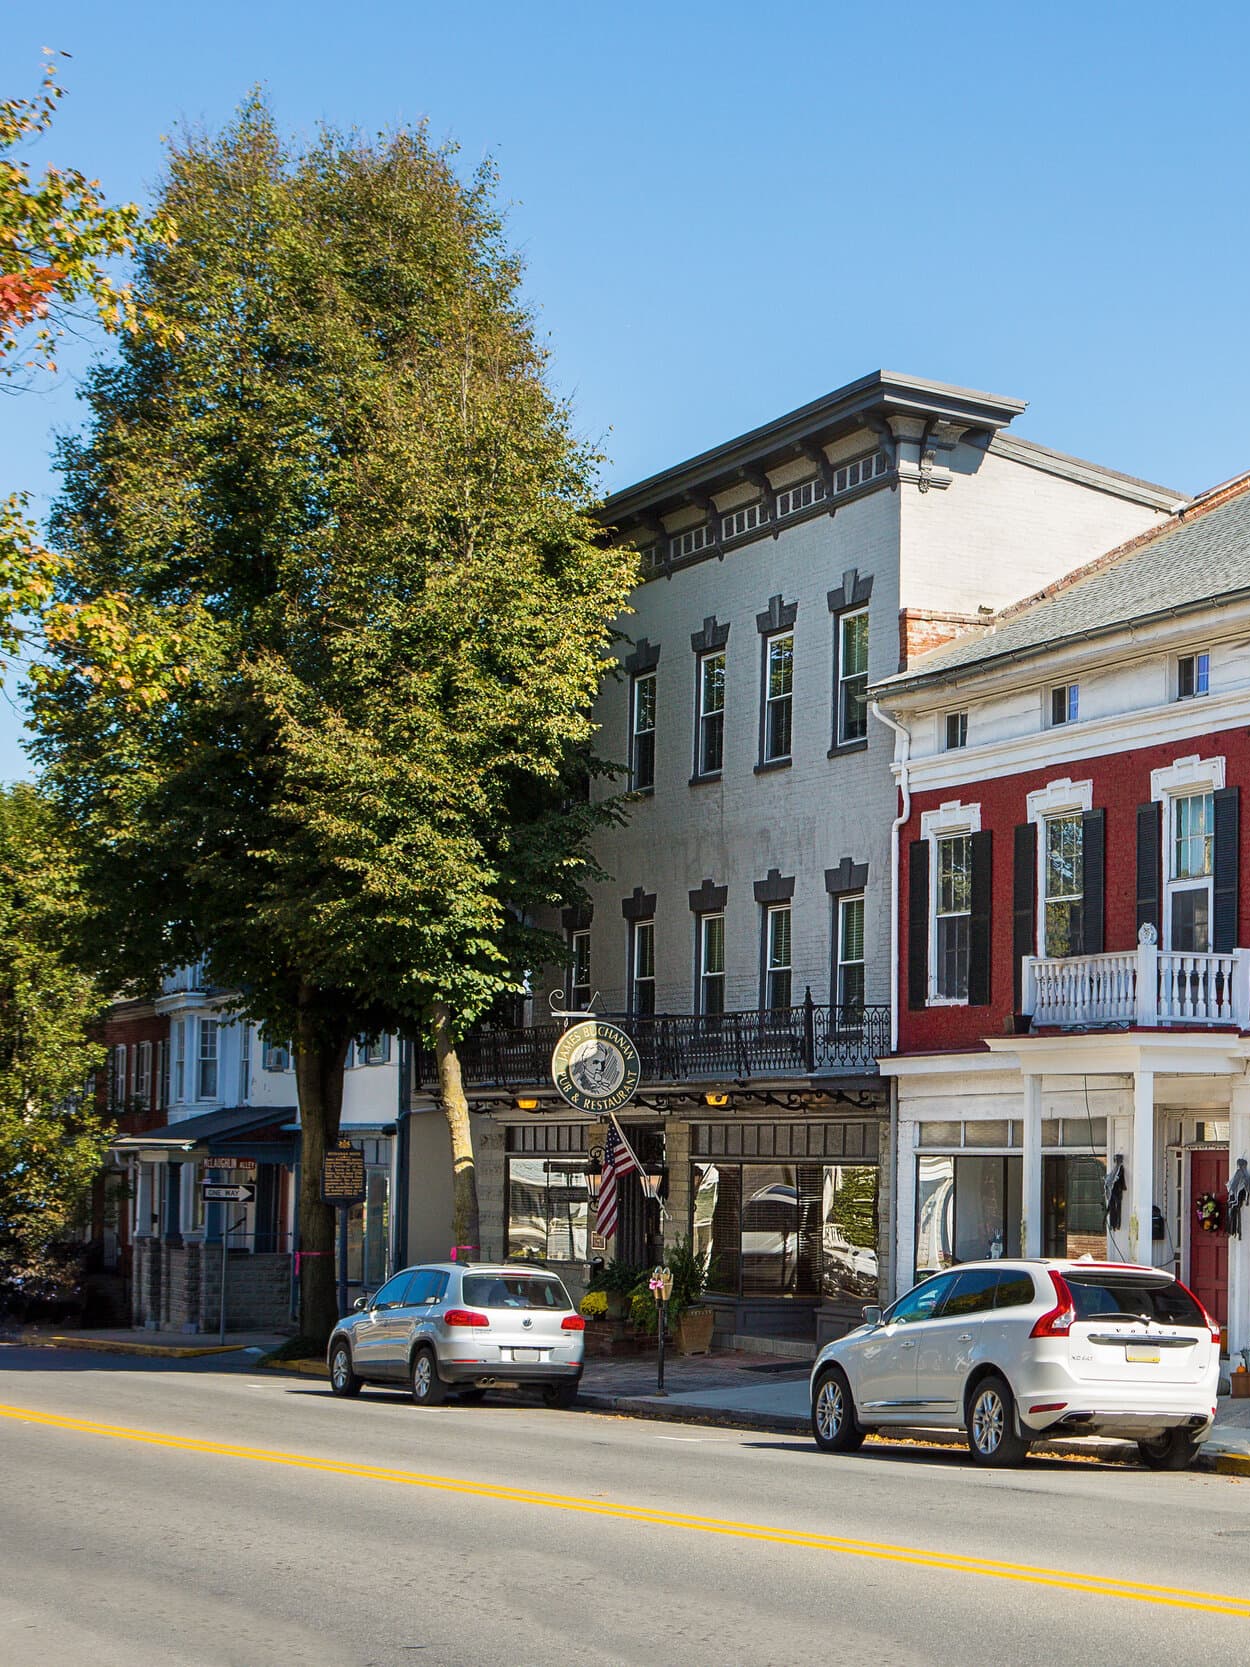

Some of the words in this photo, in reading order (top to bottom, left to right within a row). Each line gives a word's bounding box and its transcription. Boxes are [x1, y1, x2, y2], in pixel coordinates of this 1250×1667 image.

[558, 1031, 582, 1061] JAMES
[583, 1026, 635, 1060] BUCHANAN
[557, 1070, 573, 1093] PUB
[571, 1092, 580, 1104] &
[583, 1070, 637, 1110] RESTAURANT
